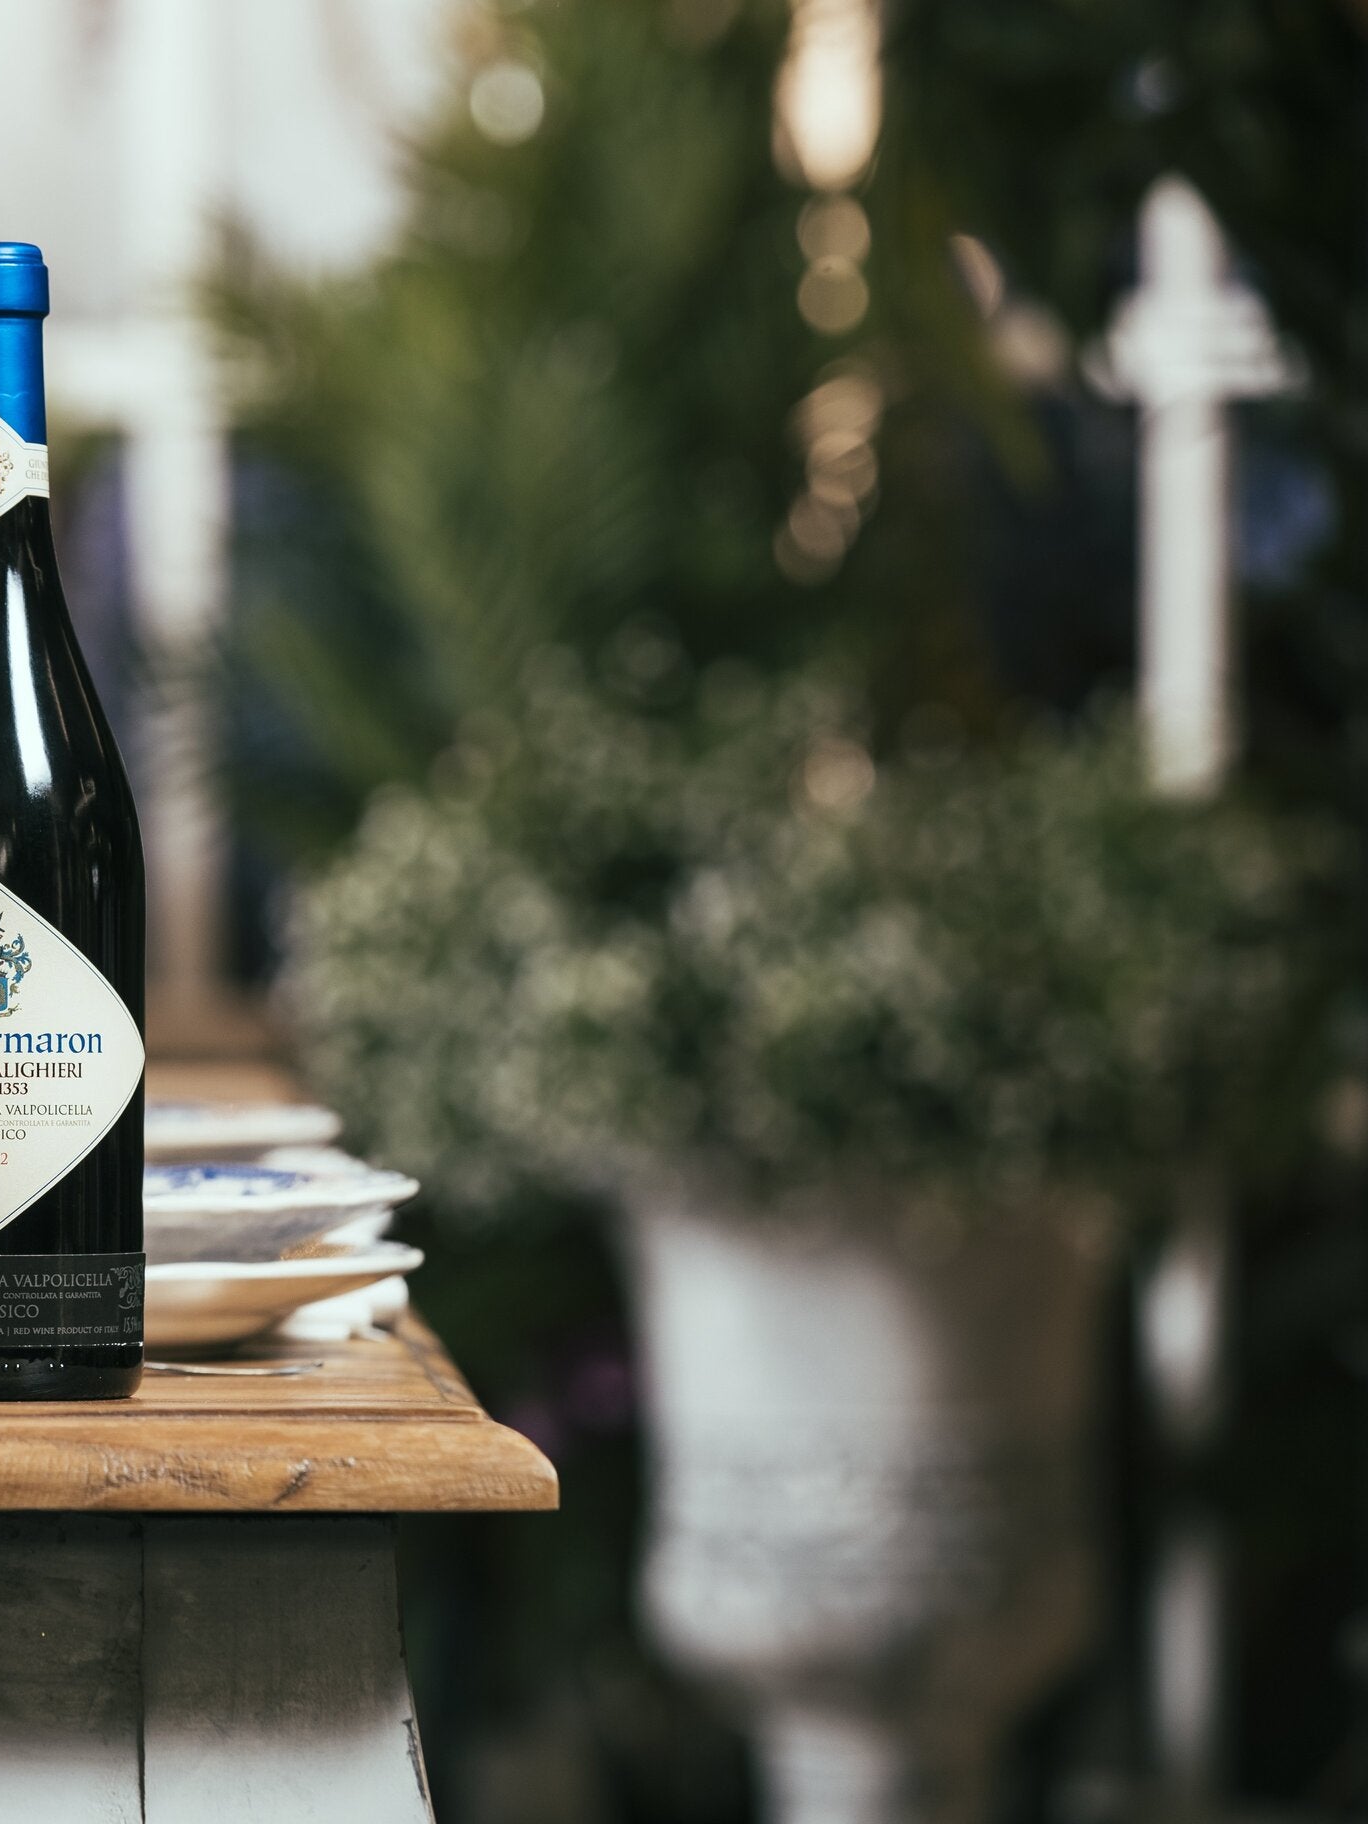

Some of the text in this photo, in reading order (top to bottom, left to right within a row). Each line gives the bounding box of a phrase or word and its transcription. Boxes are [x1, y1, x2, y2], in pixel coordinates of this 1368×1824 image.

[5, 1104, 93, 1116] VALPOLICELLA
[12, 1273, 113, 1288] VALPOLICELLA
[13, 1327, 31, 1335] RED
[32, 1327, 55, 1335] WINE
[57, 1326, 92, 1335] PRODUCT
